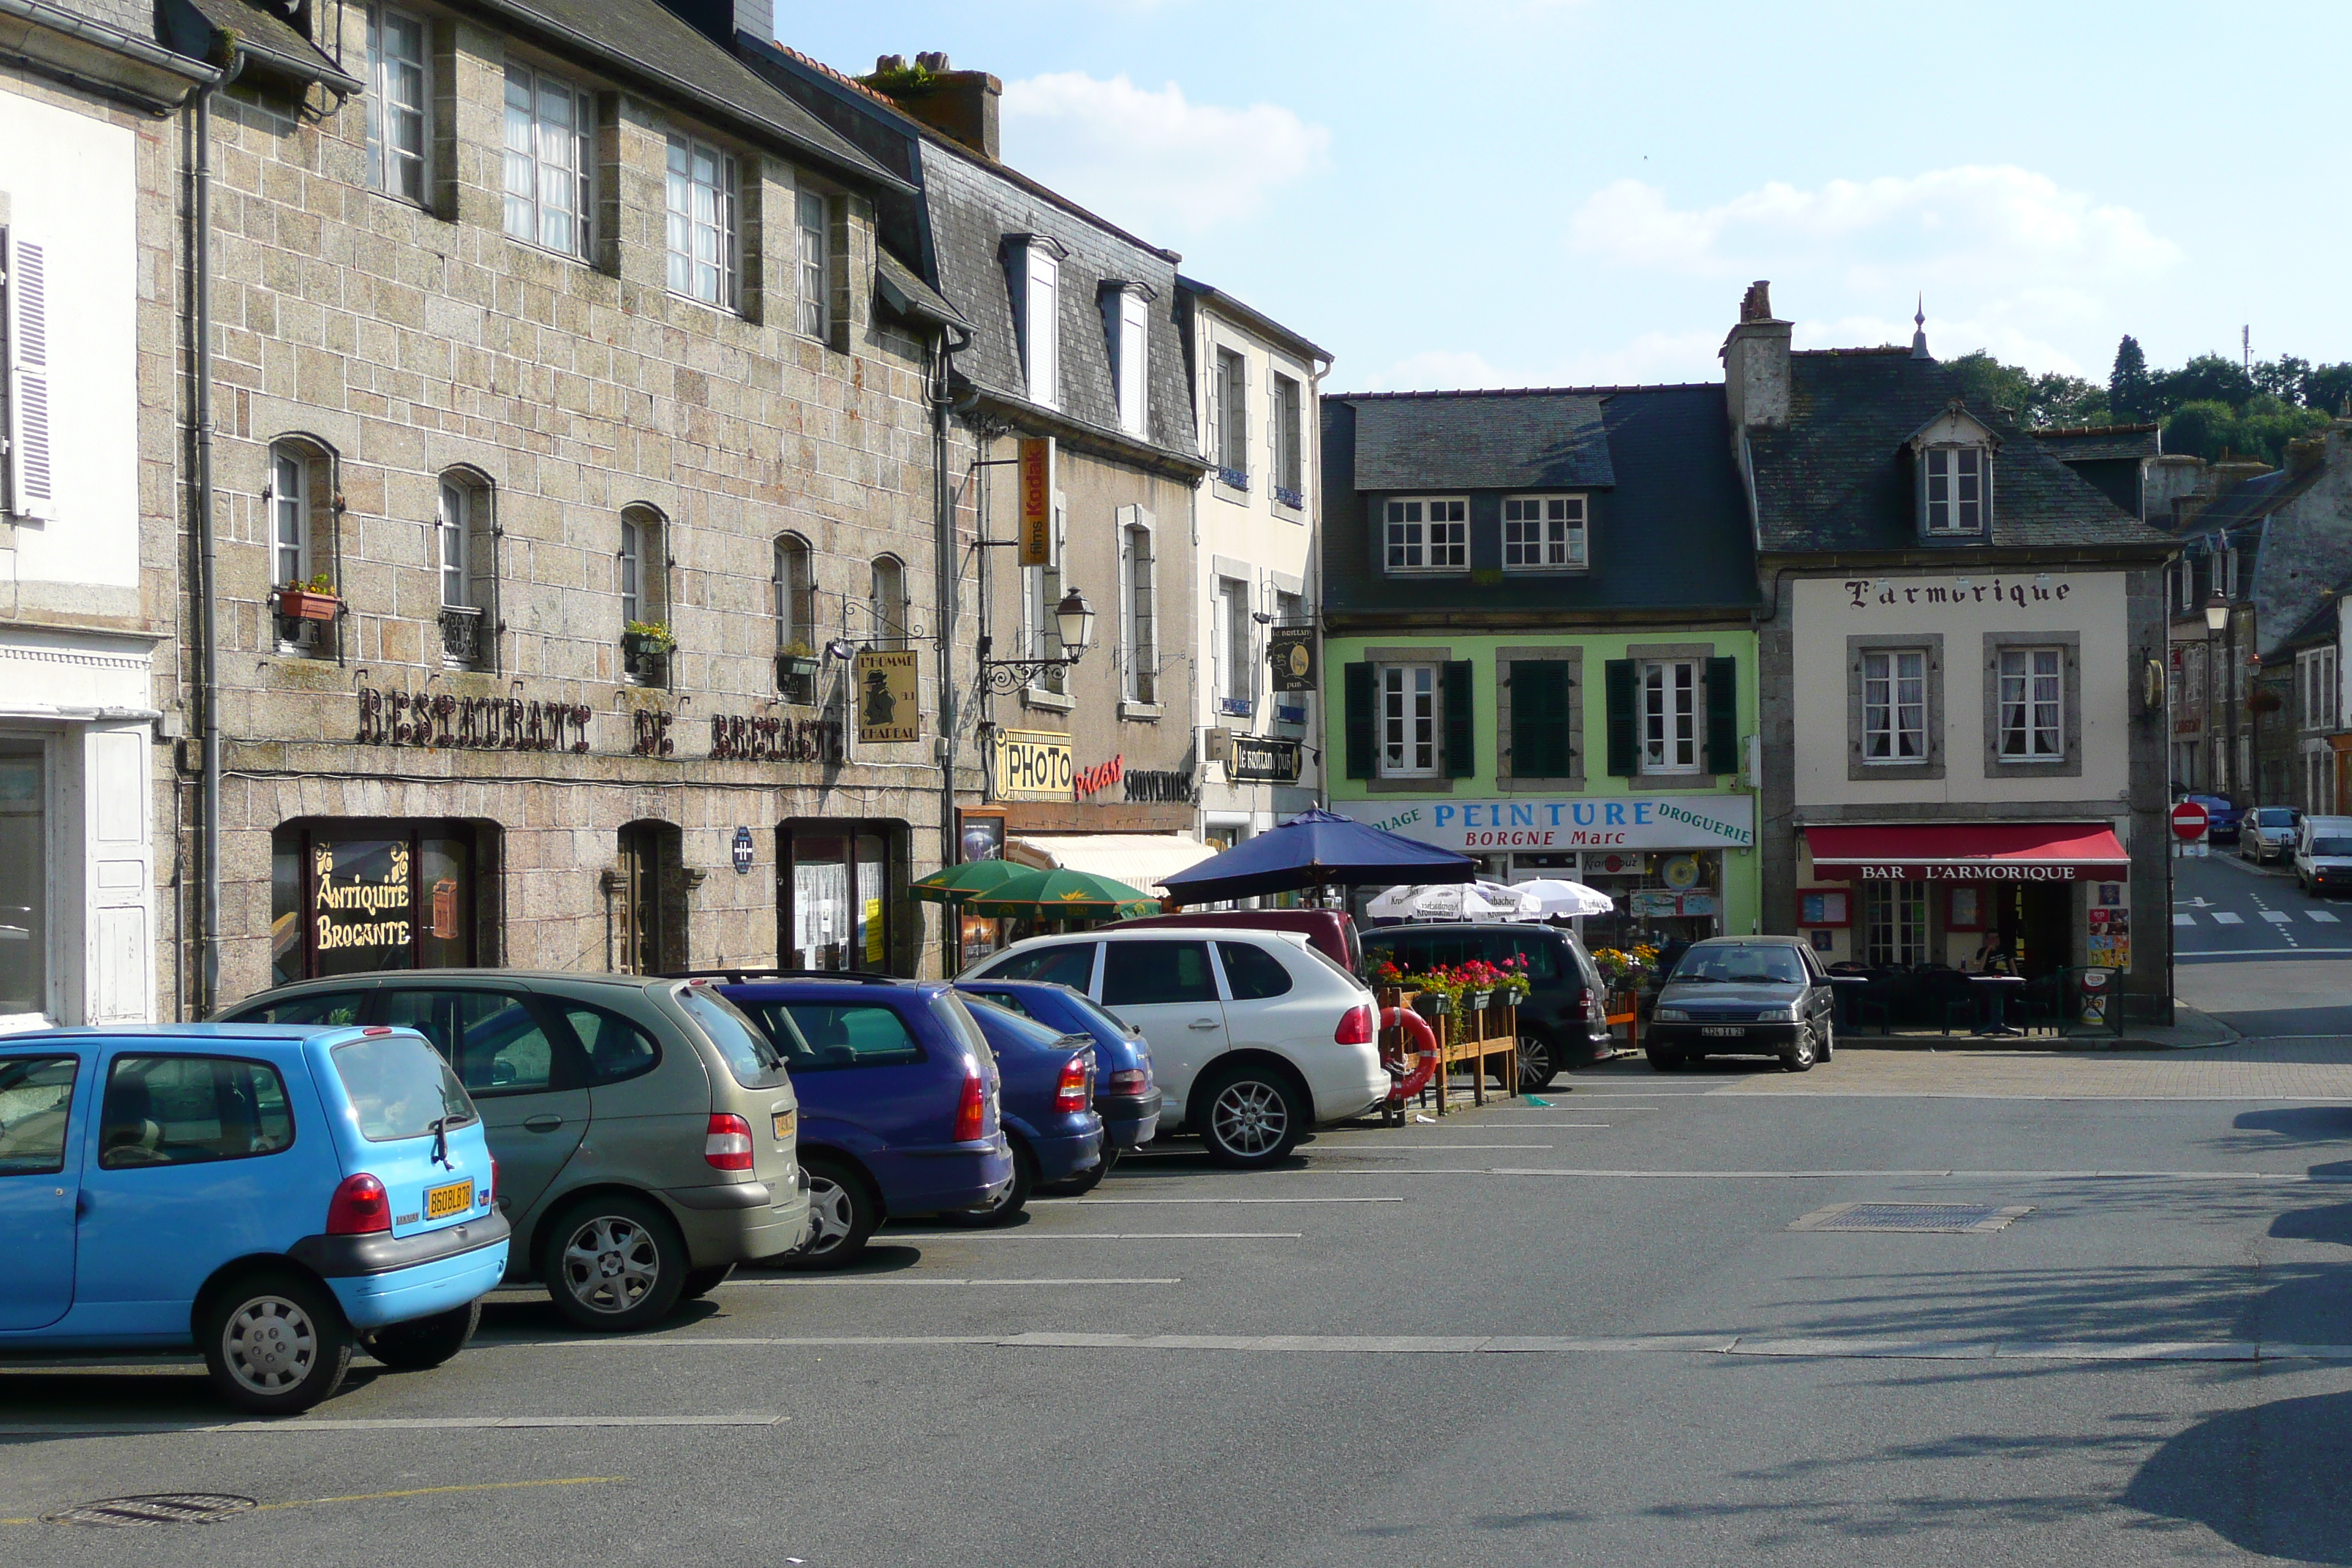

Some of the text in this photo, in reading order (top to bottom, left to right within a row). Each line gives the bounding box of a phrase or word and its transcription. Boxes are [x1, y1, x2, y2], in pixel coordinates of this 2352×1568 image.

[1026, 449, 1042, 554] films Kodak
[861, 655, 914, 668] L'HOMME
[360, 687, 844, 762] RESTAURANT DE BRETAGNE
[862, 728, 916, 739] CHAPEAU
[1009, 745, 1071, 788] PHOTO
[1123, 769, 1193, 802] SOUVENIRS
[1434, 802, 1653, 828] PEINTURE
[1658, 803, 1752, 843] DROGUERIE
[739, 841, 747, 861] H
[1466, 831, 1626, 846] BORGNE Marc
[1861, 866, 2076, 881] BAR L'ARMORIQUE
[317, 915, 409, 950] BROCANTE
